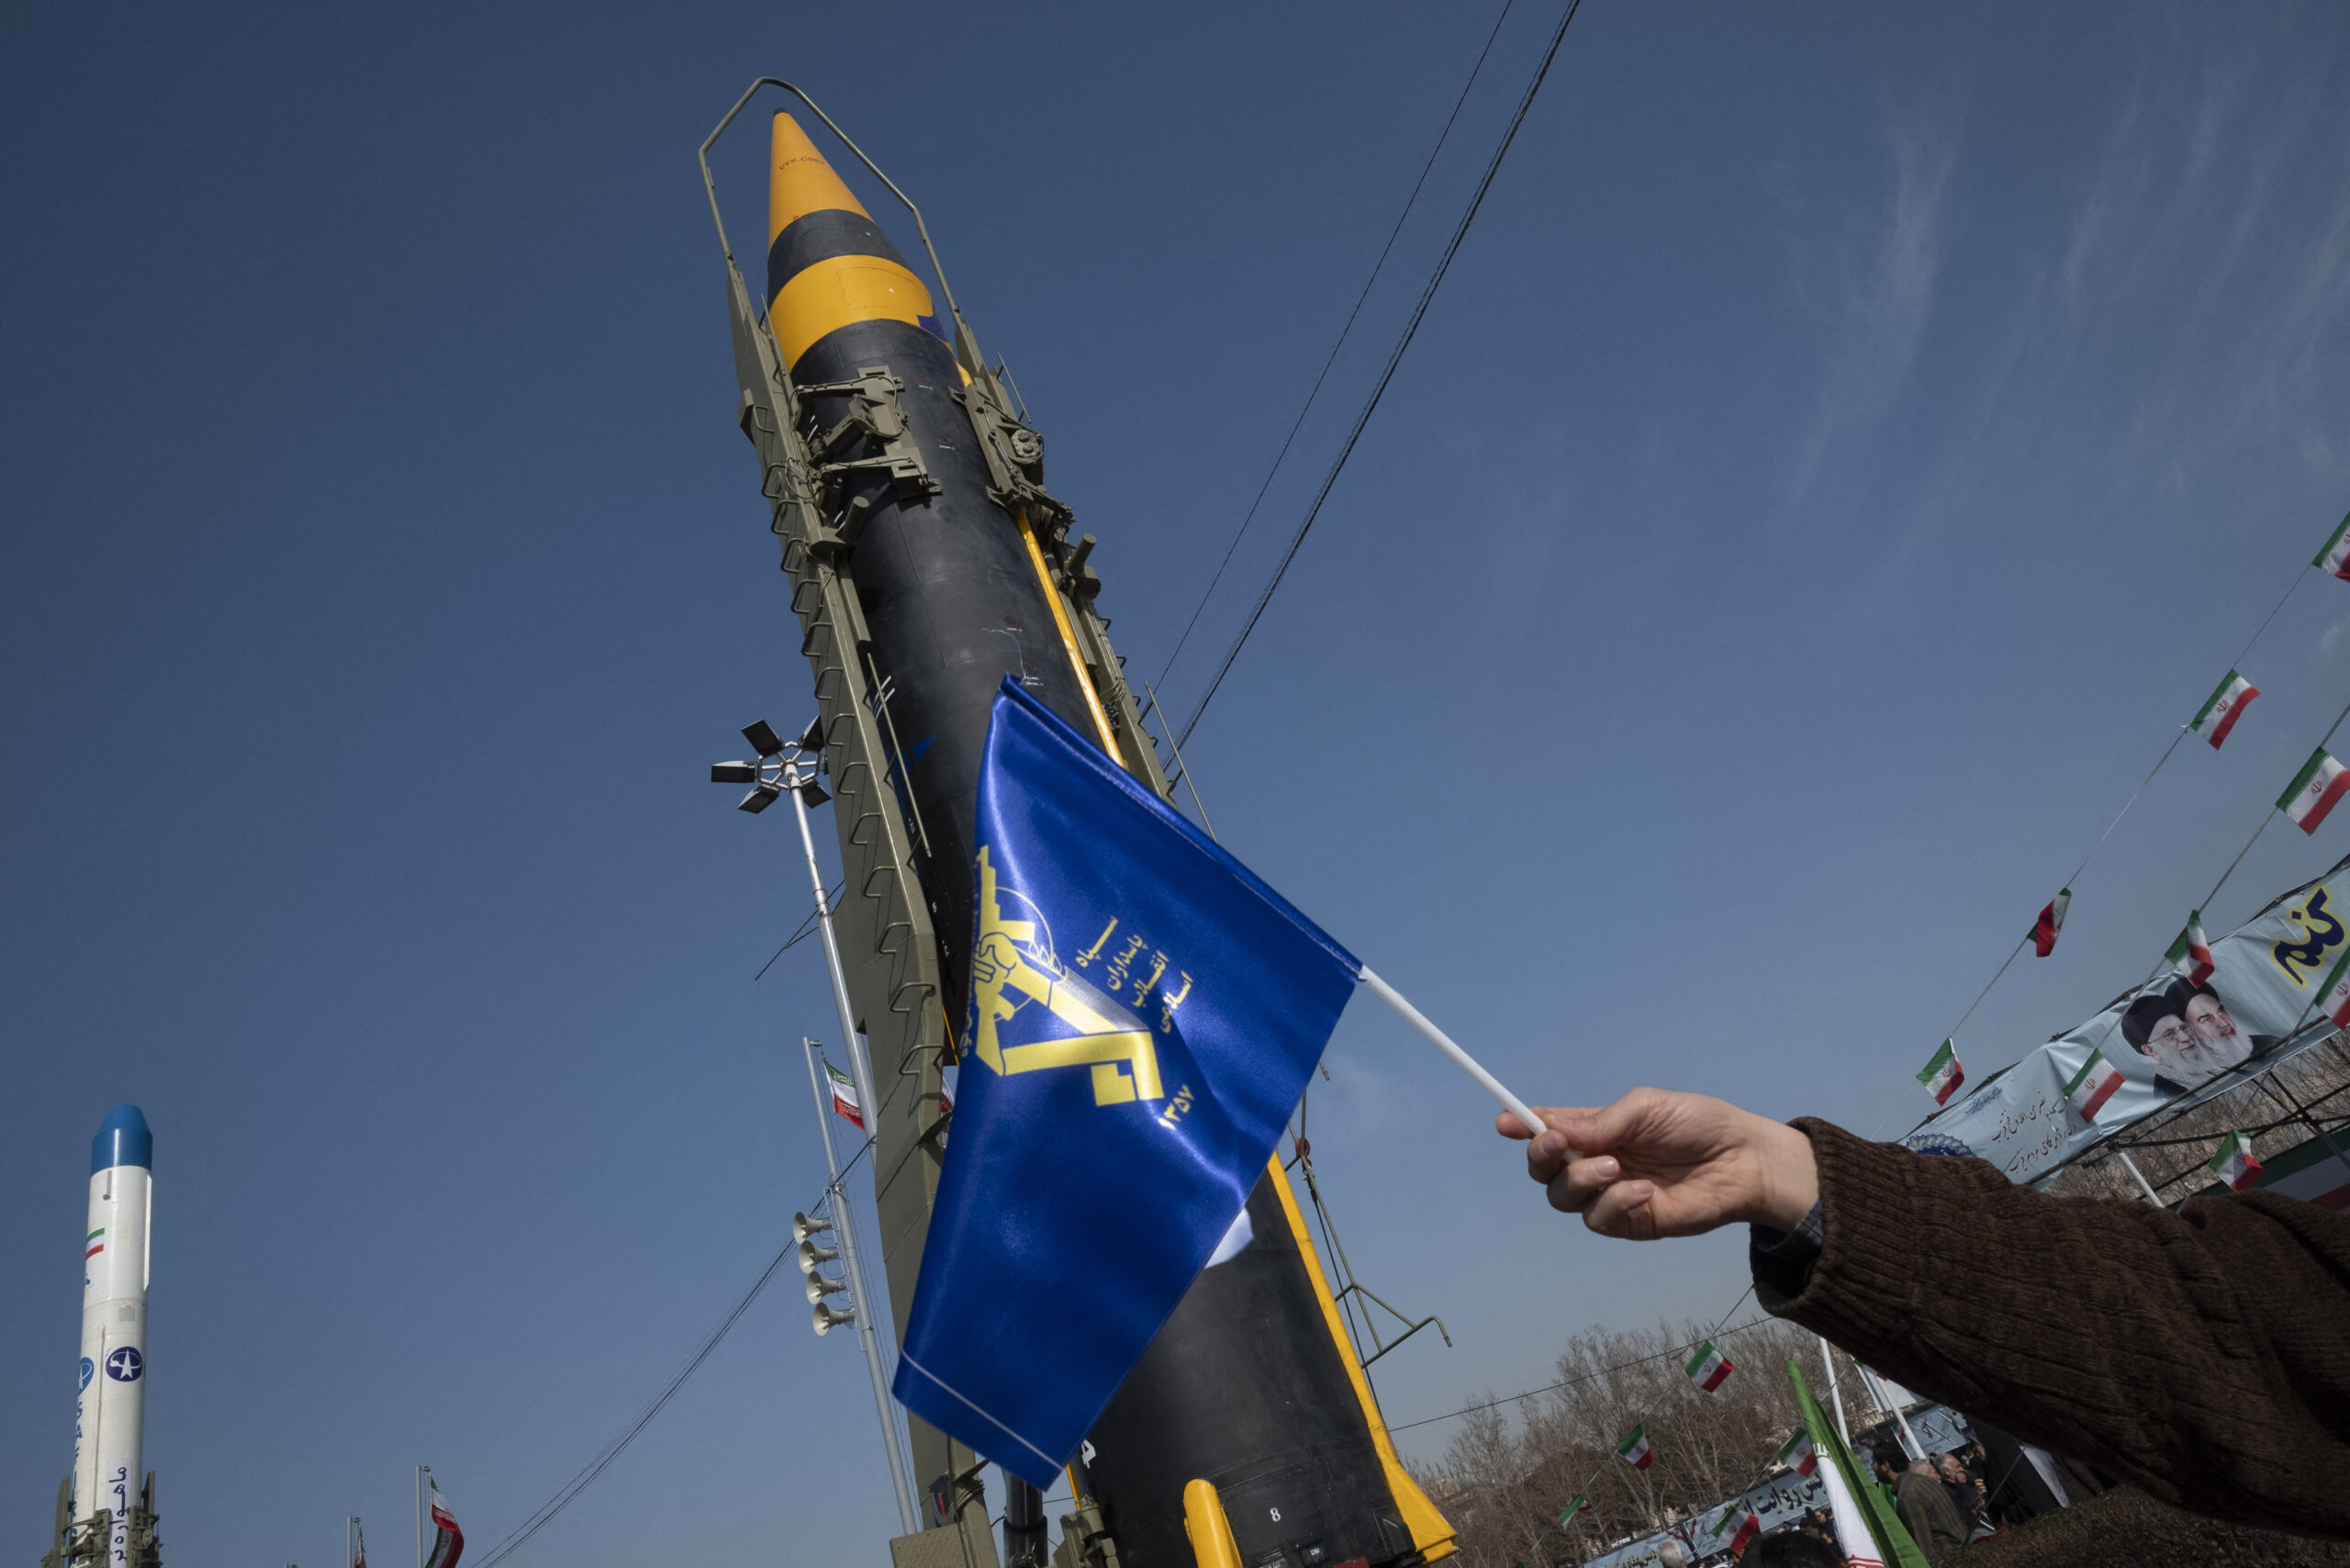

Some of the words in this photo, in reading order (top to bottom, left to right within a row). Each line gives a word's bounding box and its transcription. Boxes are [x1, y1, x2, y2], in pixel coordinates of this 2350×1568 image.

[1075, 915, 1118, 968] سپاه
[1107, 935, 1148, 991] پاسداران
[1131, 950, 1169, 1007] انقلاب
[1159, 969, 1193, 1034] اسلامی
[1158, 1083, 1195, 1131] ۱۳۵۷
[1270, 1507, 1281, 1522] 8
